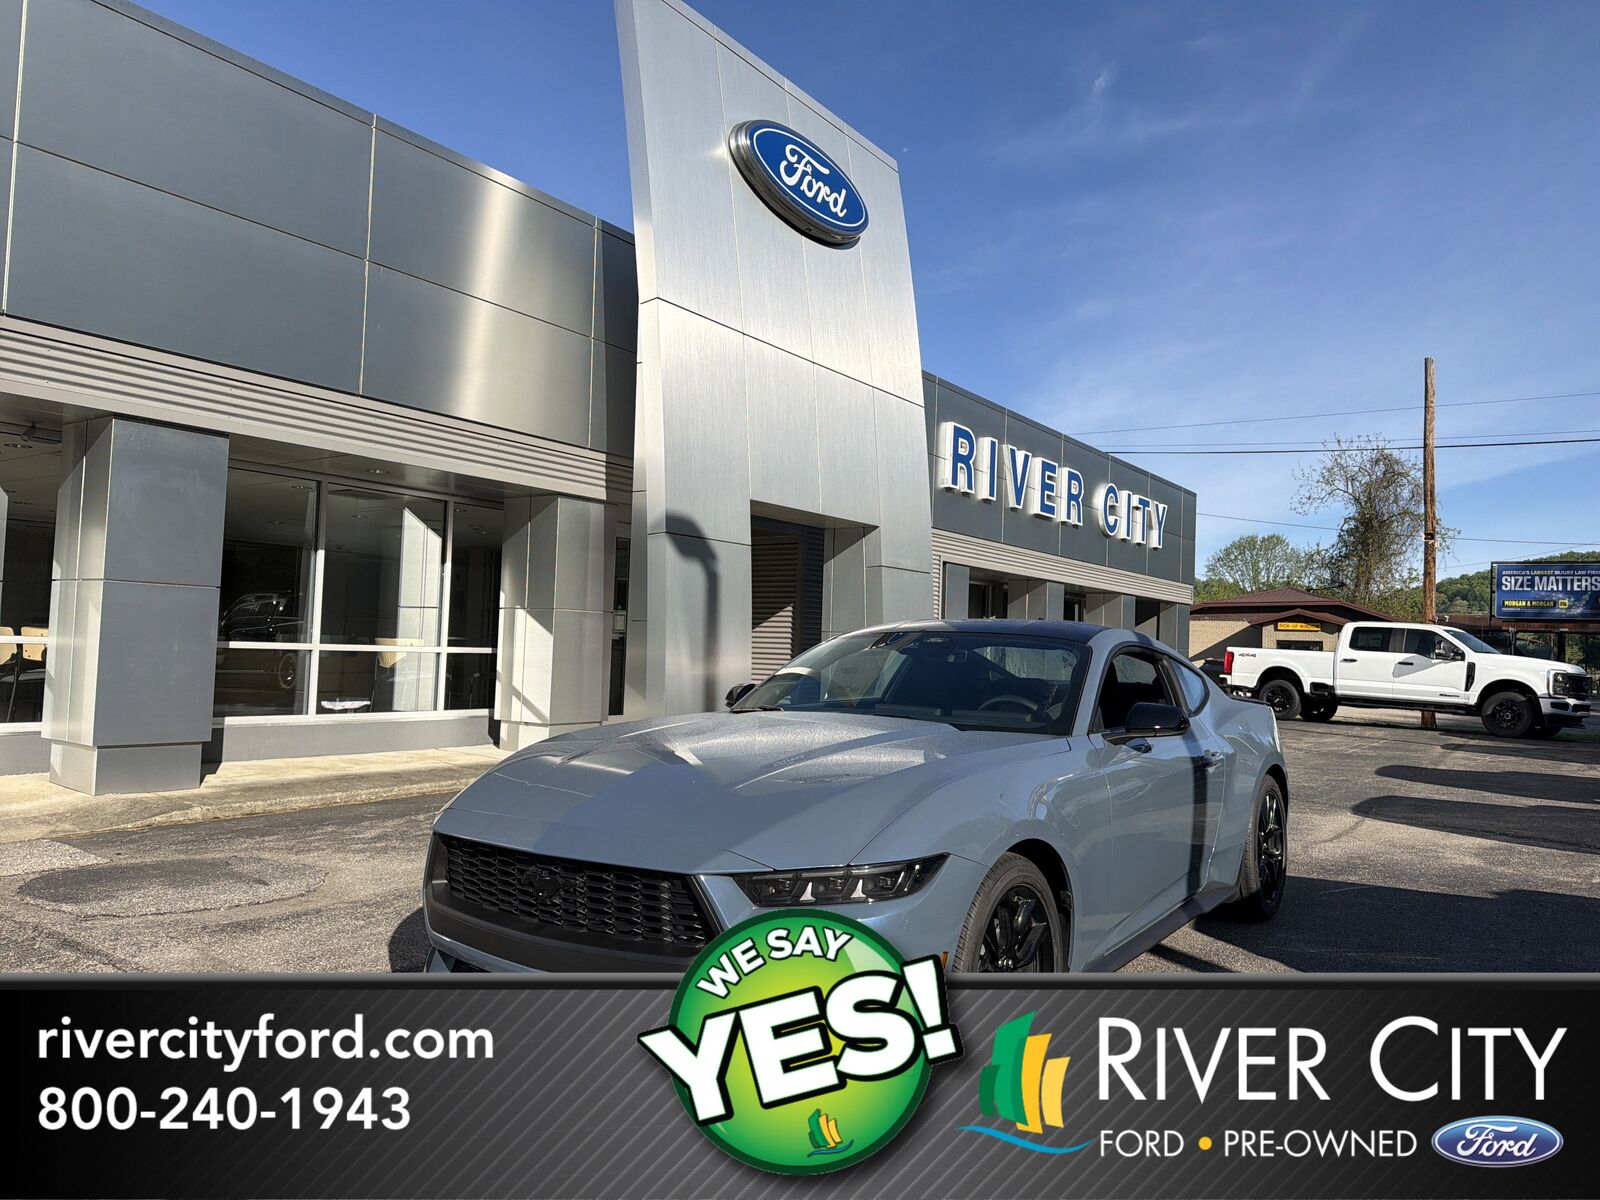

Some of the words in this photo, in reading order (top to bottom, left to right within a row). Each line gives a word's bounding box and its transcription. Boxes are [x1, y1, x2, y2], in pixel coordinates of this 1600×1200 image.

[780, 144, 847, 217] Ford
[941, 421, 1083, 526] RIVER
[1097, 482, 1168, 549] CITY
[1501, 576, 1531, 591] SIZE
[1534, 576, 1600, 591] MATTERS
